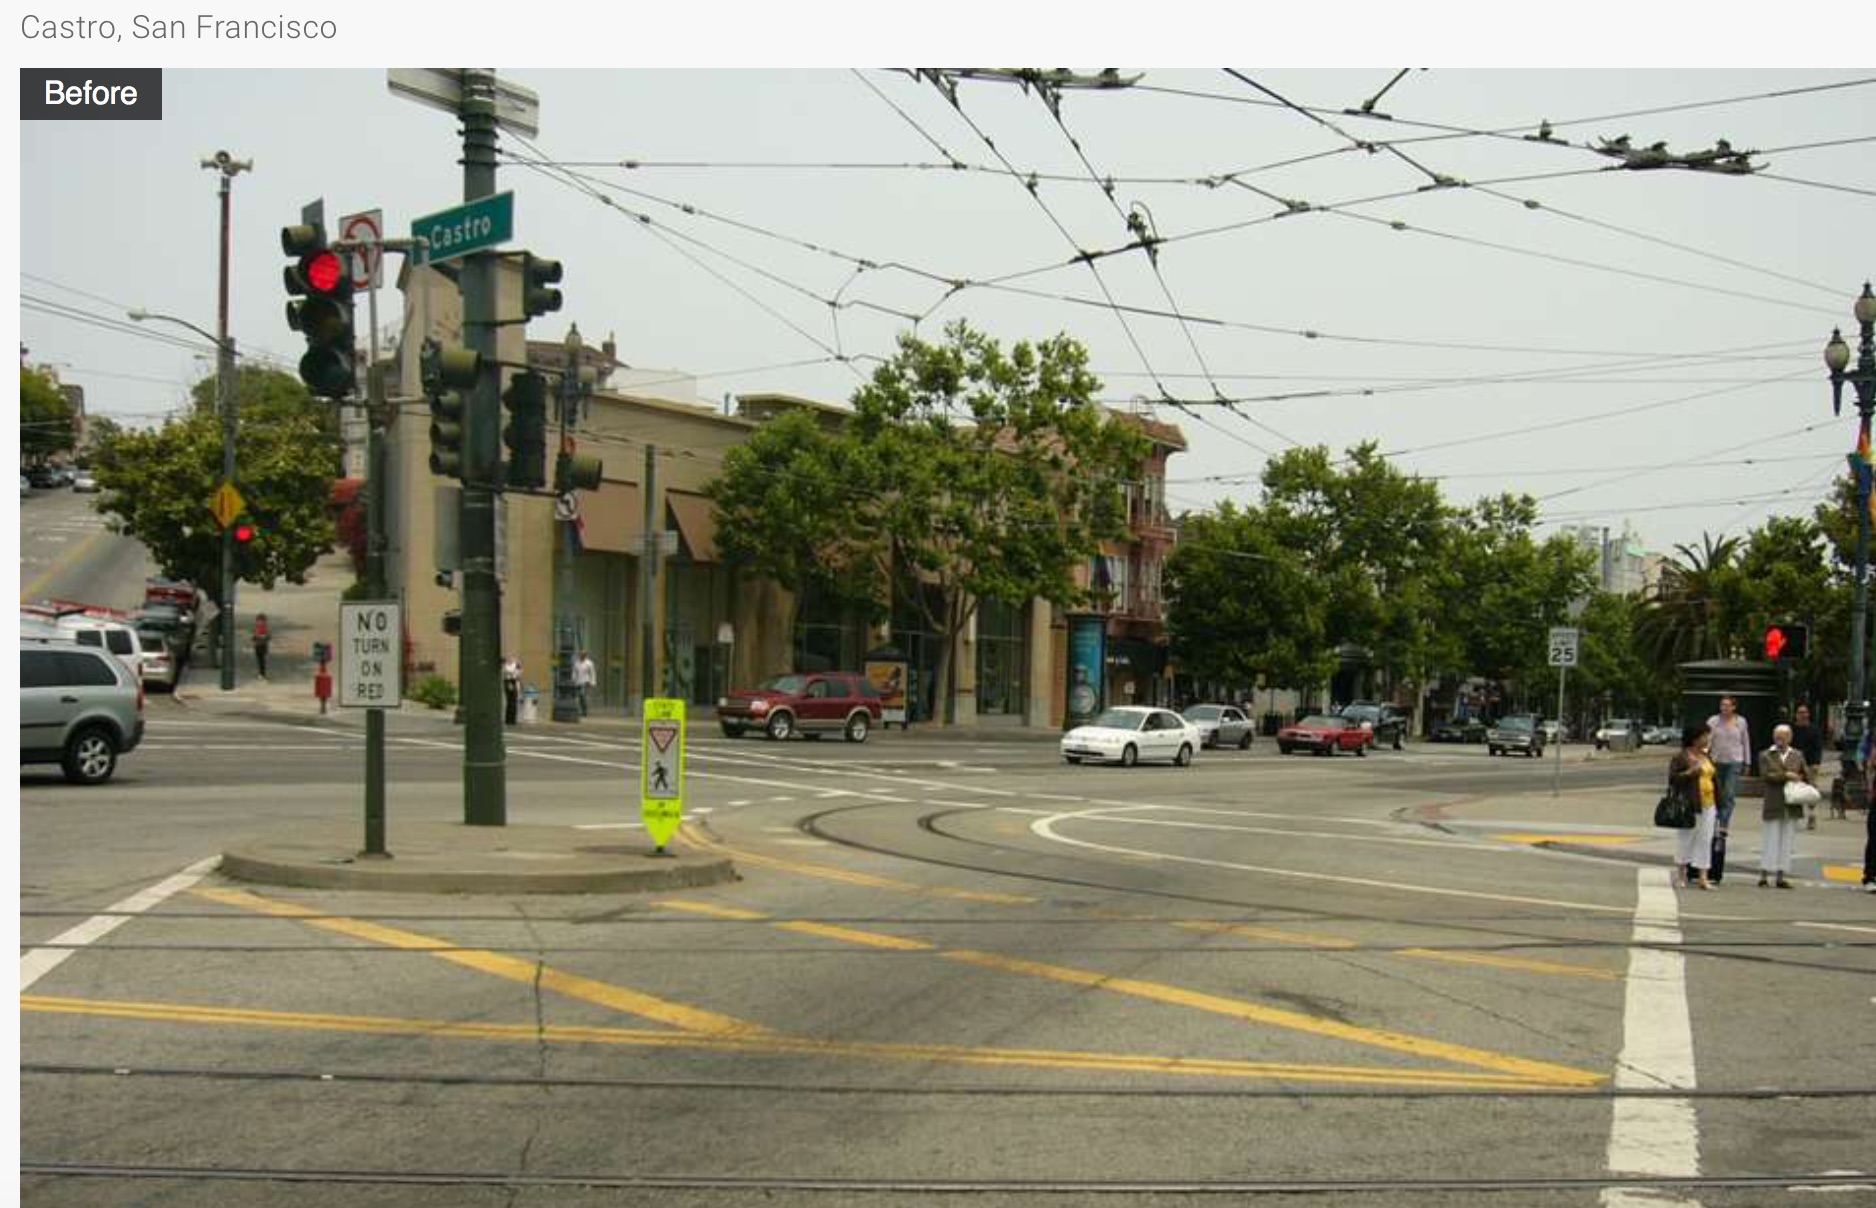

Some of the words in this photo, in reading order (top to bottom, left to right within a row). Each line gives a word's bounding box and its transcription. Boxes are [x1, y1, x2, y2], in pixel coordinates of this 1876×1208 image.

[430, 215, 492, 250] Castro
[357, 611, 388, 633] NO
[352, 638, 390, 654] TURN
[1551, 647, 1575, 663] 25
[361, 660, 383, 677] ON
[357, 682, 385, 699] RED
